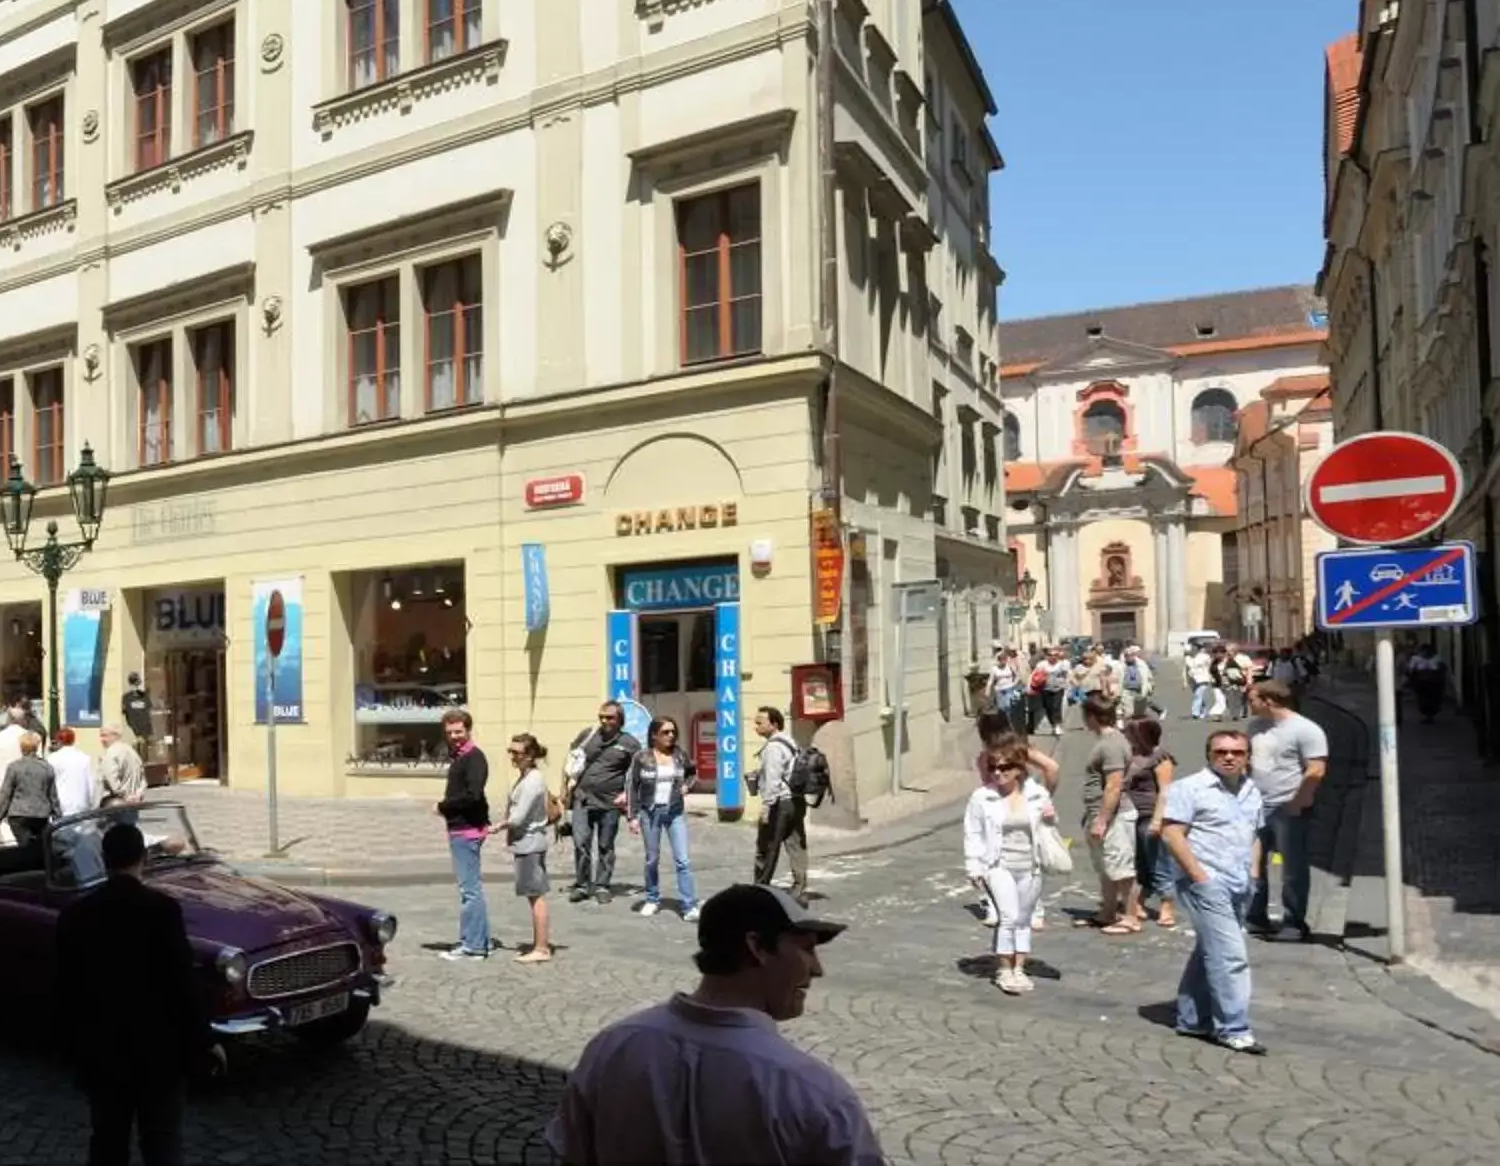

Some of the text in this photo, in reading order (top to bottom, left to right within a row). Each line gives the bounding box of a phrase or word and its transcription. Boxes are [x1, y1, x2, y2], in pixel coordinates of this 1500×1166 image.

[615, 501, 739, 537] CHANGE
[80, 590, 108, 605] BLUE
[626, 570, 740, 606] CHANGE
[273, 705, 300, 717] BLUE
[720, 633, 737, 779] CHANGE
